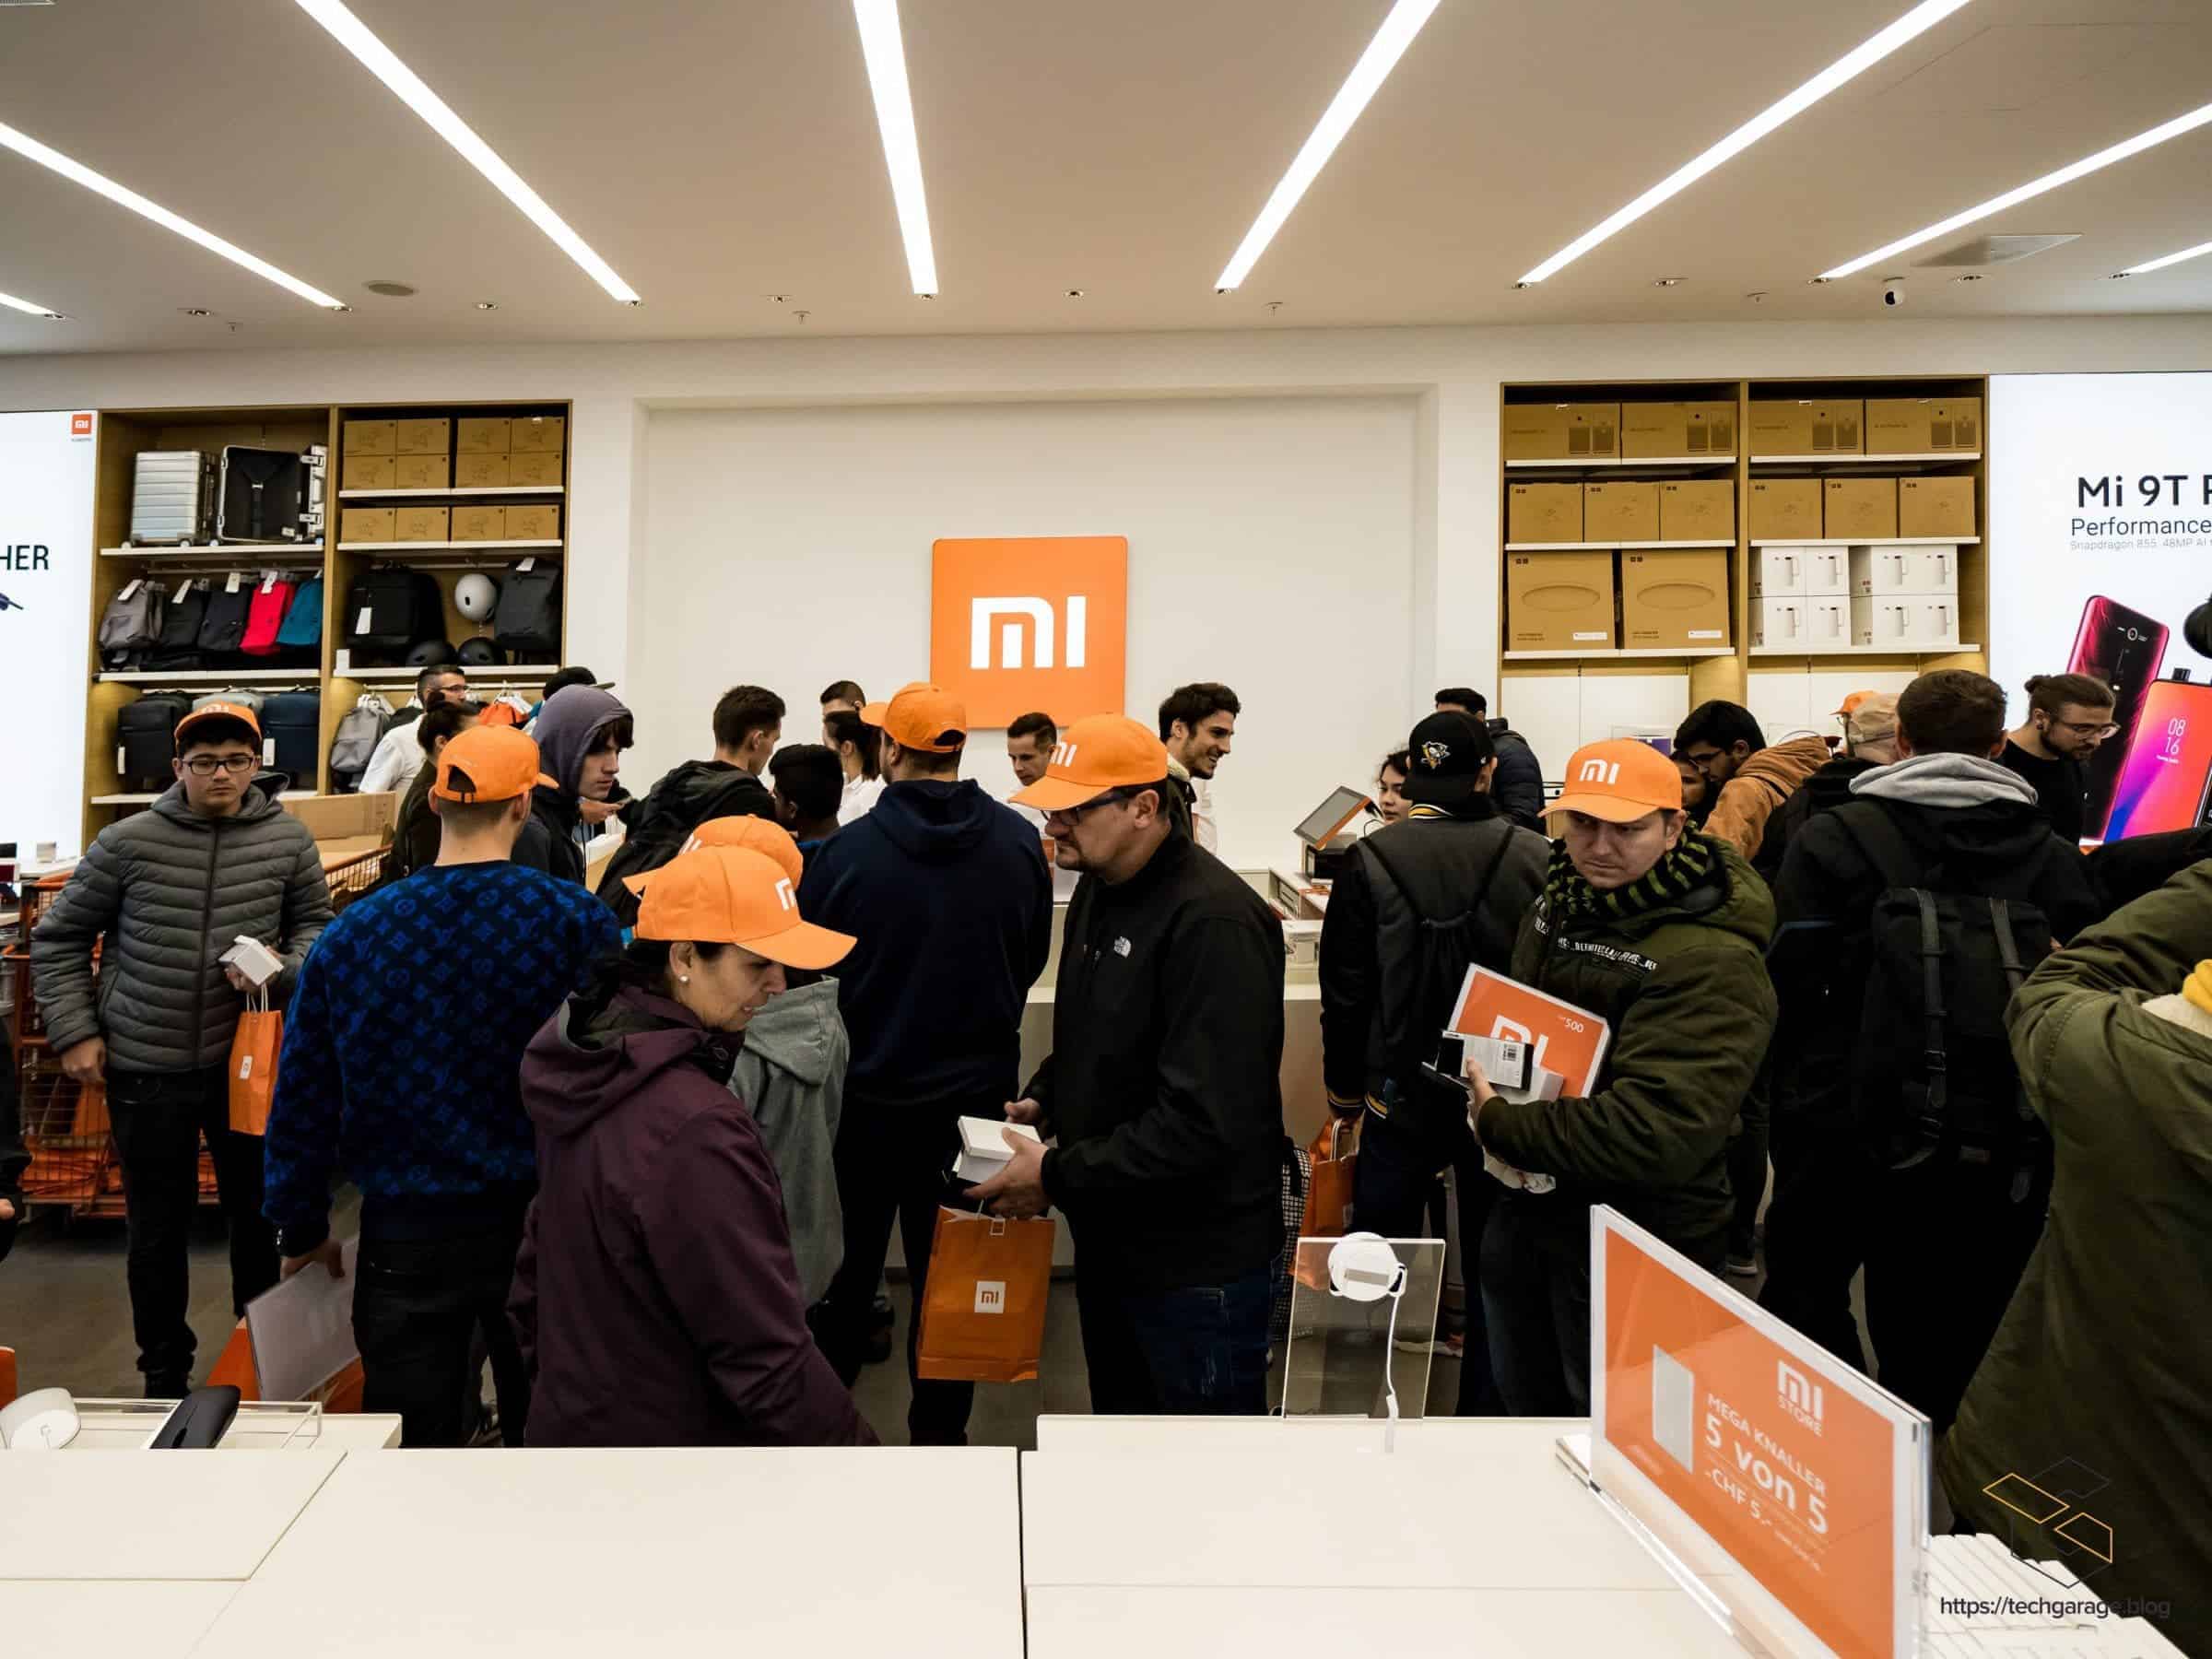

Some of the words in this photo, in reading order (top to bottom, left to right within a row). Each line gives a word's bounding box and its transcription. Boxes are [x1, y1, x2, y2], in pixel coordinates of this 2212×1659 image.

[2077, 476, 2124, 508] Mi
[2137, 475, 2189, 507] 9T
[2071, 516, 2212, 536] Performance
[2071, 539, 2135, 551] Snapdragon
[2167, 718, 2186, 736] 08
[2165, 736, 2182, 756] 16
[1565, 1018, 1584, 1033] 500
[1777, 1393, 1823, 1438] STORE
[1707, 1392, 1751, 1438] MEGA
[1753, 1428, 1826, 1498] KNALLER
[1705, 1413, 1722, 1449] 5
[1734, 1440, 1795, 1512] von
[1807, 1493, 1828, 1535] 5
